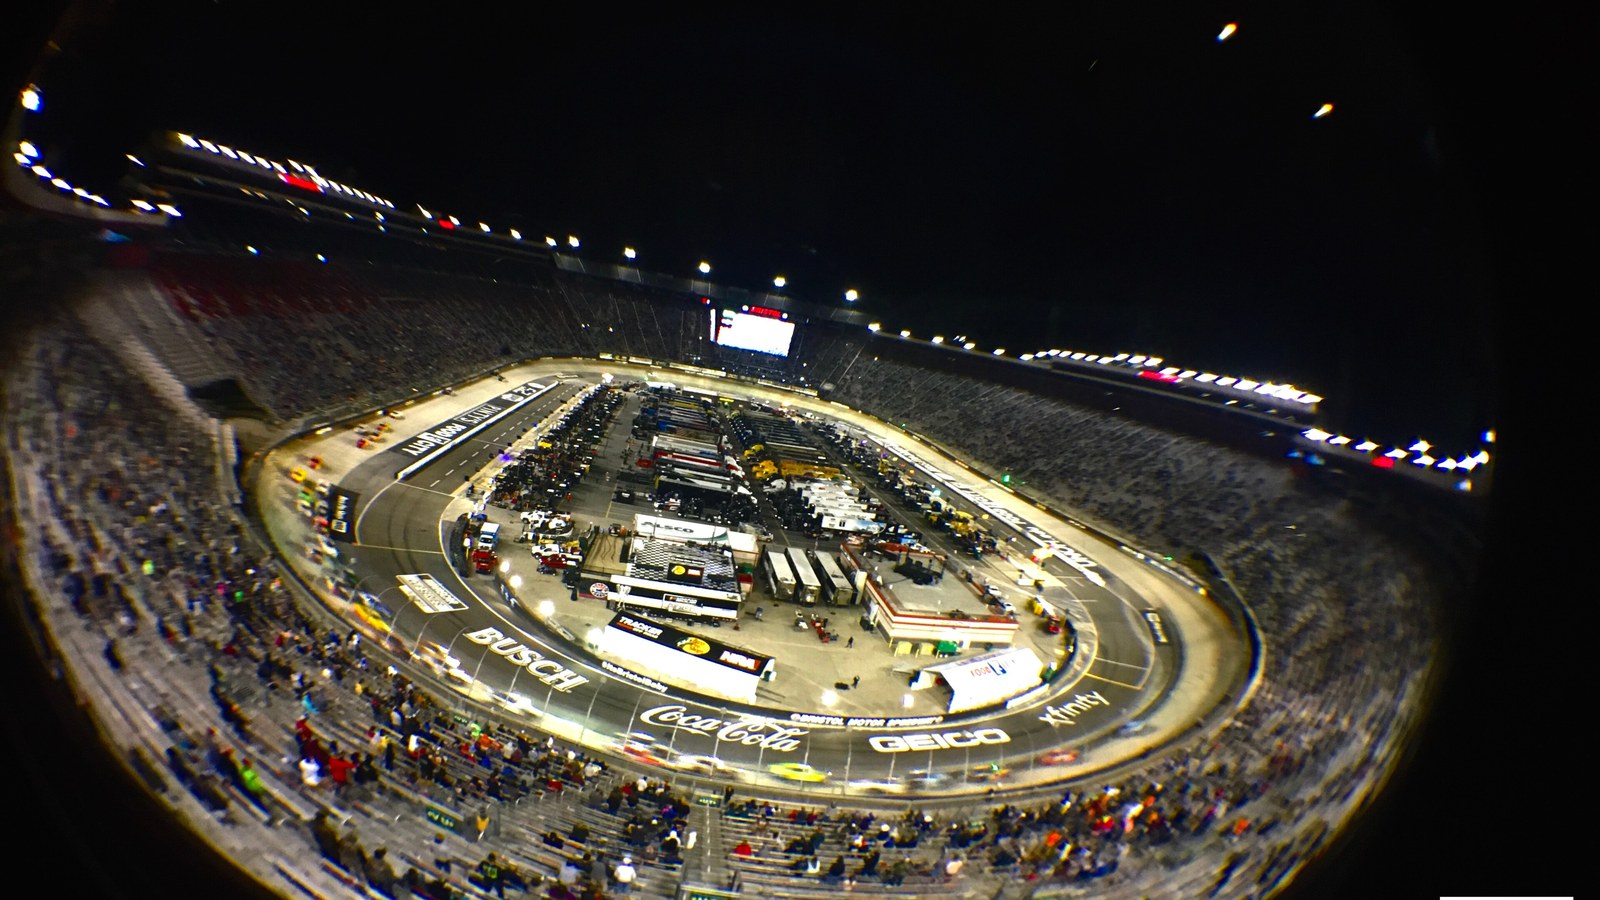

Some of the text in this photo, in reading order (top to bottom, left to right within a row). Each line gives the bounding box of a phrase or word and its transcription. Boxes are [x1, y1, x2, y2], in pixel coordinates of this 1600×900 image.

[402, 436, 430, 456] CITY
[619, 616, 663, 635] TRACKER
[464, 627, 588, 692] BUSCH
[1039, 690, 1110, 728] xfinity
[640, 705, 810, 752] Coca-Cola
[868, 728, 1011, 753] GEICO
